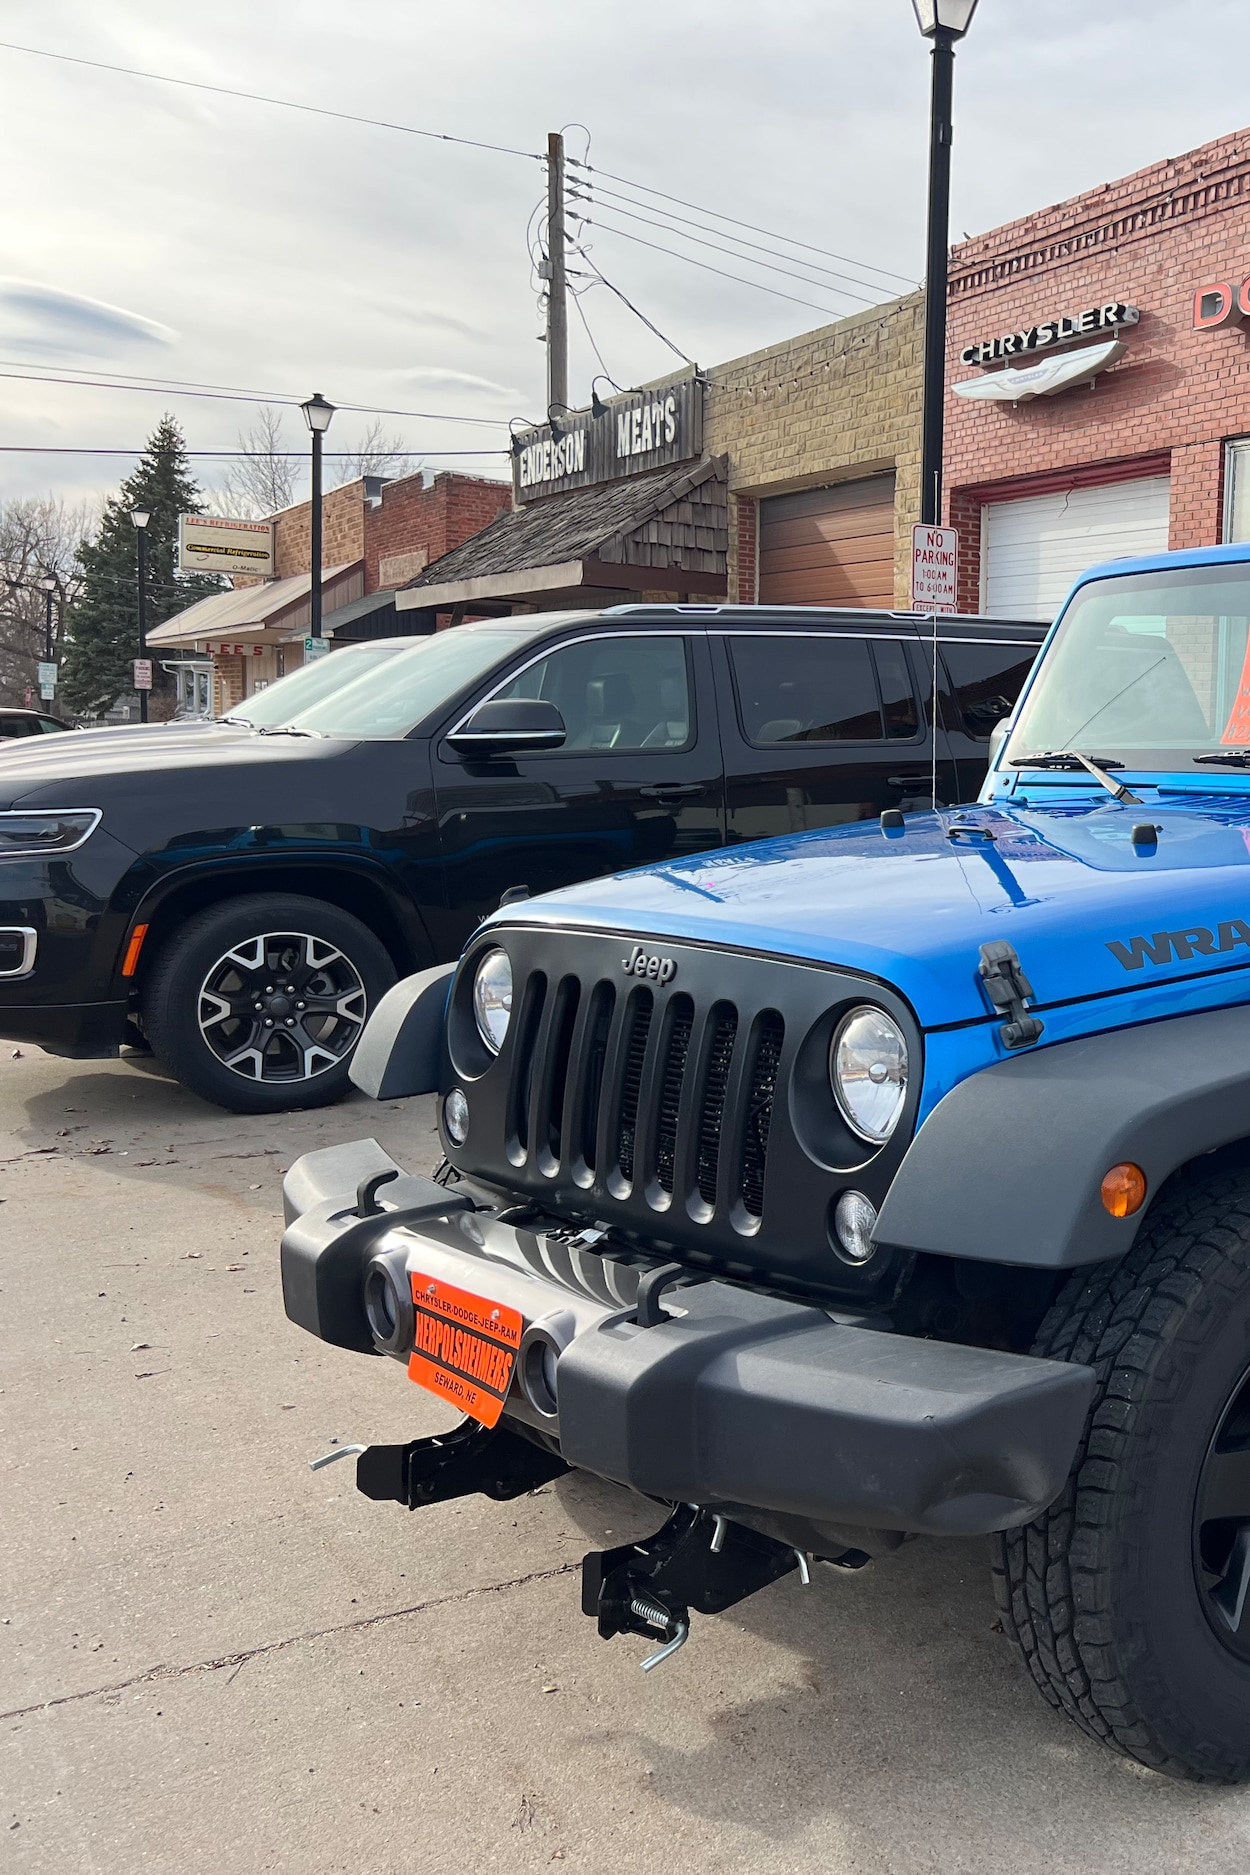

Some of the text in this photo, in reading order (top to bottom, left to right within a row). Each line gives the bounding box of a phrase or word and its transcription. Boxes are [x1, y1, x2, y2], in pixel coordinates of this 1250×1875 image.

[959, 302, 1121, 366] CHRYSLER
[520, 396, 677, 488] ENDERSON MEATS
[209, 519, 270, 532] REFRIGERATION
[926, 532, 943, 548] NO
[187, 543, 269, 559] Commercial Refrigeration
[915, 548, 954, 566] PARKING
[915, 581, 924, 592] TO
[621, 946, 677, 987] Jeep
[415, 1310, 514, 1394] HERPOLSHEIMERS
[465, 1388, 477, 1405] NE
